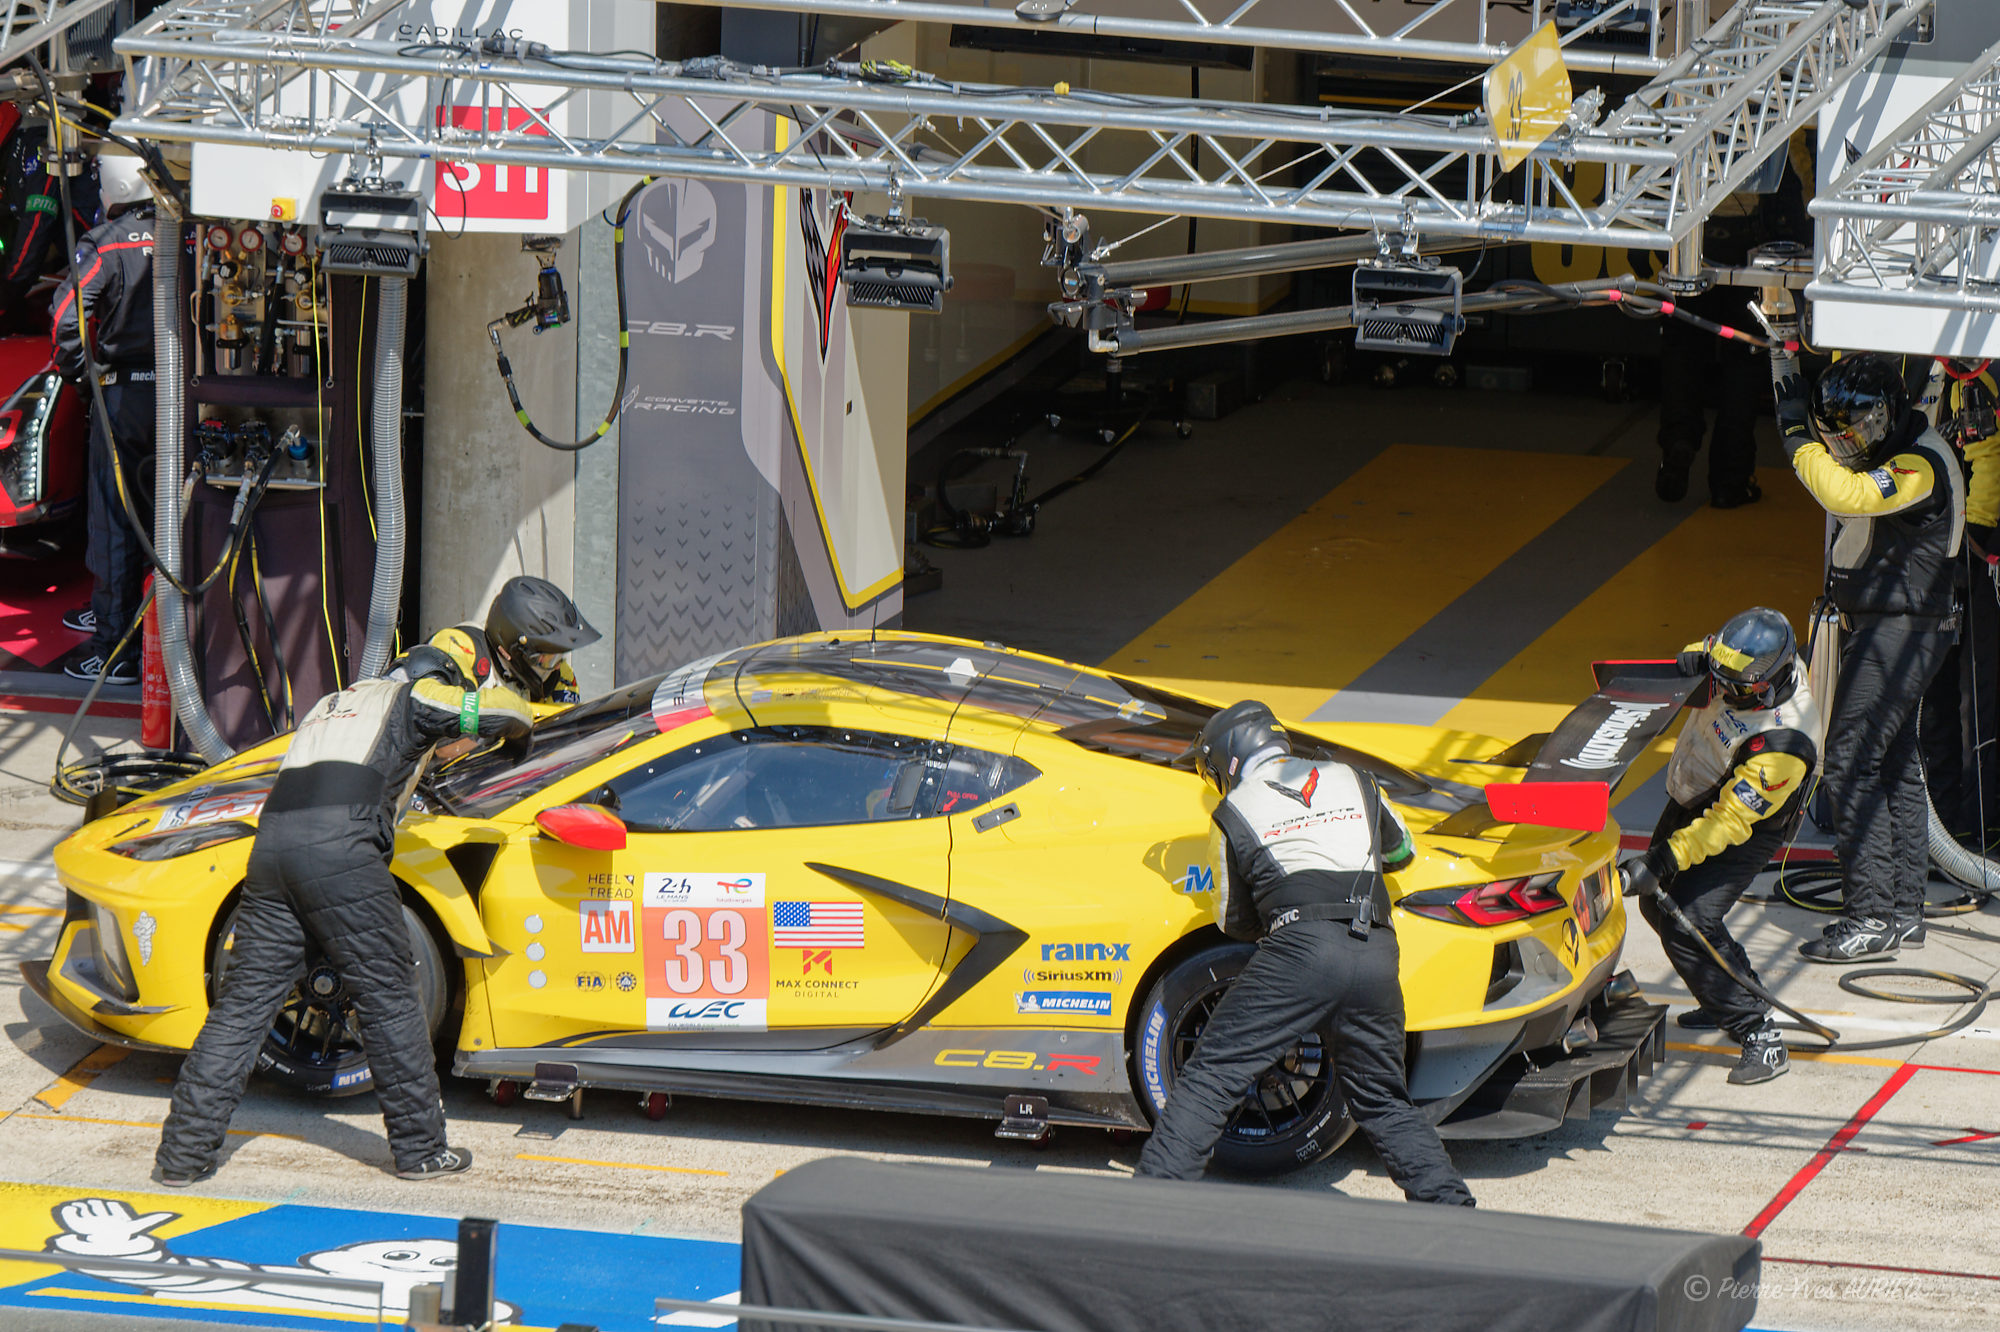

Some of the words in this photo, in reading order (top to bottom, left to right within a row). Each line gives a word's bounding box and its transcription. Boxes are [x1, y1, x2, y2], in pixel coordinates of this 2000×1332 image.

[398, 24, 523, 39] CADILLAC
[633, 401, 737, 415] RACING
[644, 395, 729, 407] CORVETTE
[1271, 807, 1356, 829] CORVETTE
[1262, 813, 1362, 840] RACING
[588, 873, 621, 885] HEEL
[588, 887, 634, 899] TREAD
[583, 910, 631, 944] AM
[662, 909, 749, 995] 33
[775, 980, 801, 989] MAX
[805, 980, 859, 989] CONNECT
[667, 1000, 746, 1019] WEC
[1041, 997, 1111, 1011] MICHELIN
[934, 1048, 1101, 1076] C8.R
[1019, 1103, 1034, 1115] LR
